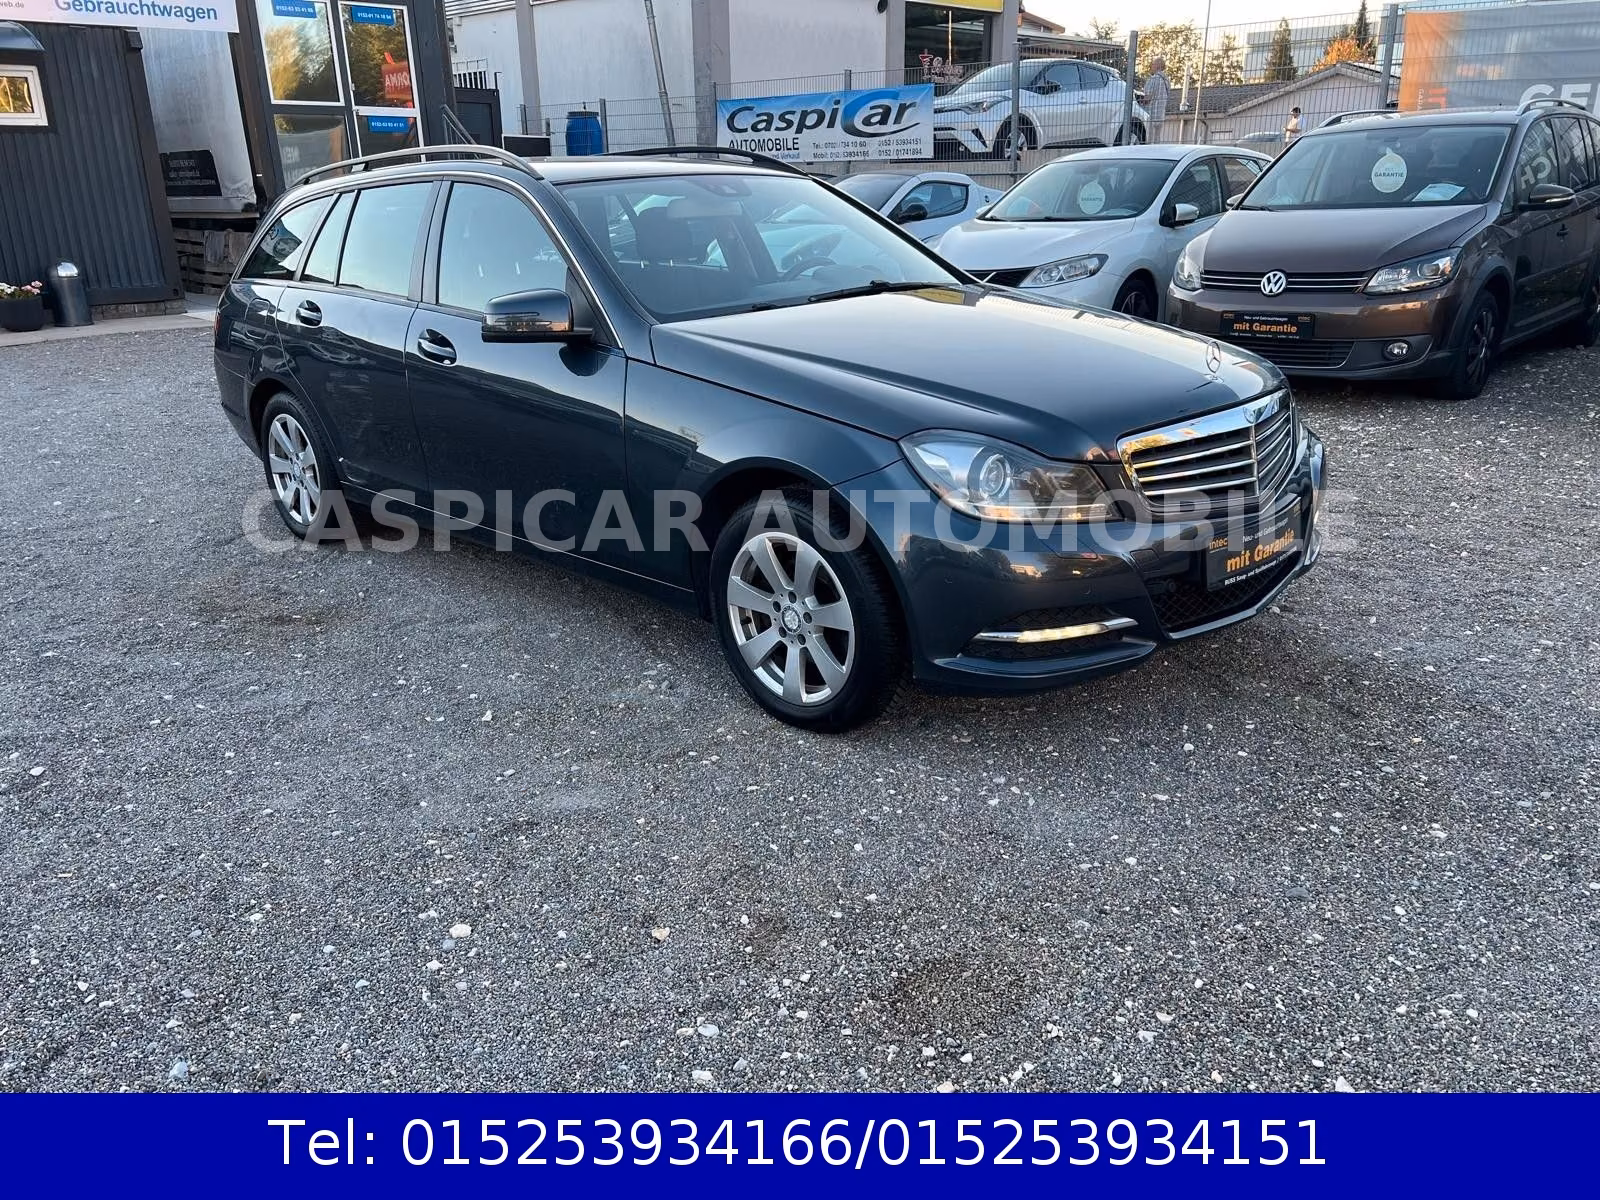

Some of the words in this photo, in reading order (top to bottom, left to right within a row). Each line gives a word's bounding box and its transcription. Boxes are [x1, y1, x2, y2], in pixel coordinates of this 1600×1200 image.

[54, 0, 219, 23] Gebrauchtwagen
[726, 88, 921, 138] CaspiCar
[729, 137, 800, 153] AUTOMOBILE
[1233, 321, 1250, 331] mit
[1252, 322, 1298, 333] Garantie
[1226, 549, 1251, 573] mit
[1253, 527, 1295, 562] Garantie
